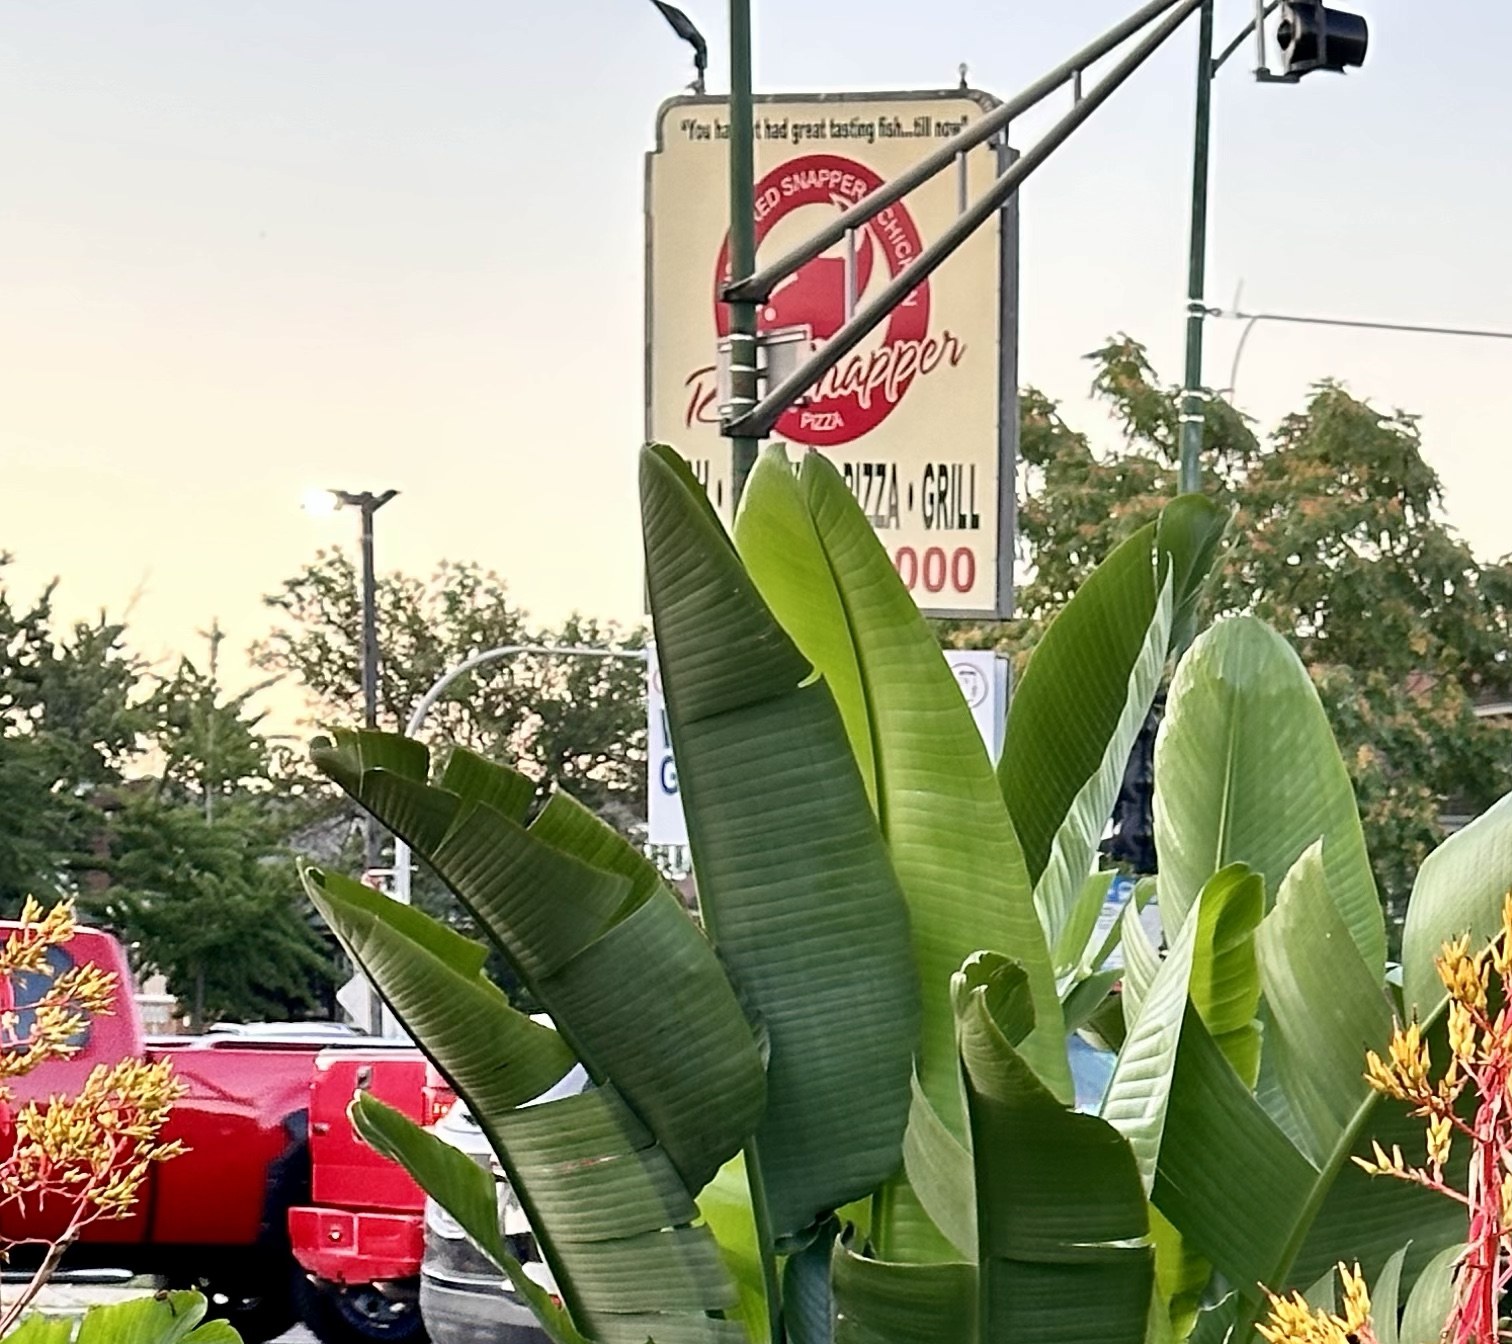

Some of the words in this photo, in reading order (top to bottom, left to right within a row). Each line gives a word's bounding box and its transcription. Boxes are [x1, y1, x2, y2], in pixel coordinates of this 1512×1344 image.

[764, 119, 788, 139] had
[792, 121, 827, 144] great
[830, 116, 874, 144] tasting
[754, 186, 780, 222] ED
[781, 170, 867, 199] SNAPPER
[801, 412, 843, 430] PIZZA
[921, 463, 980, 529] GRILL
